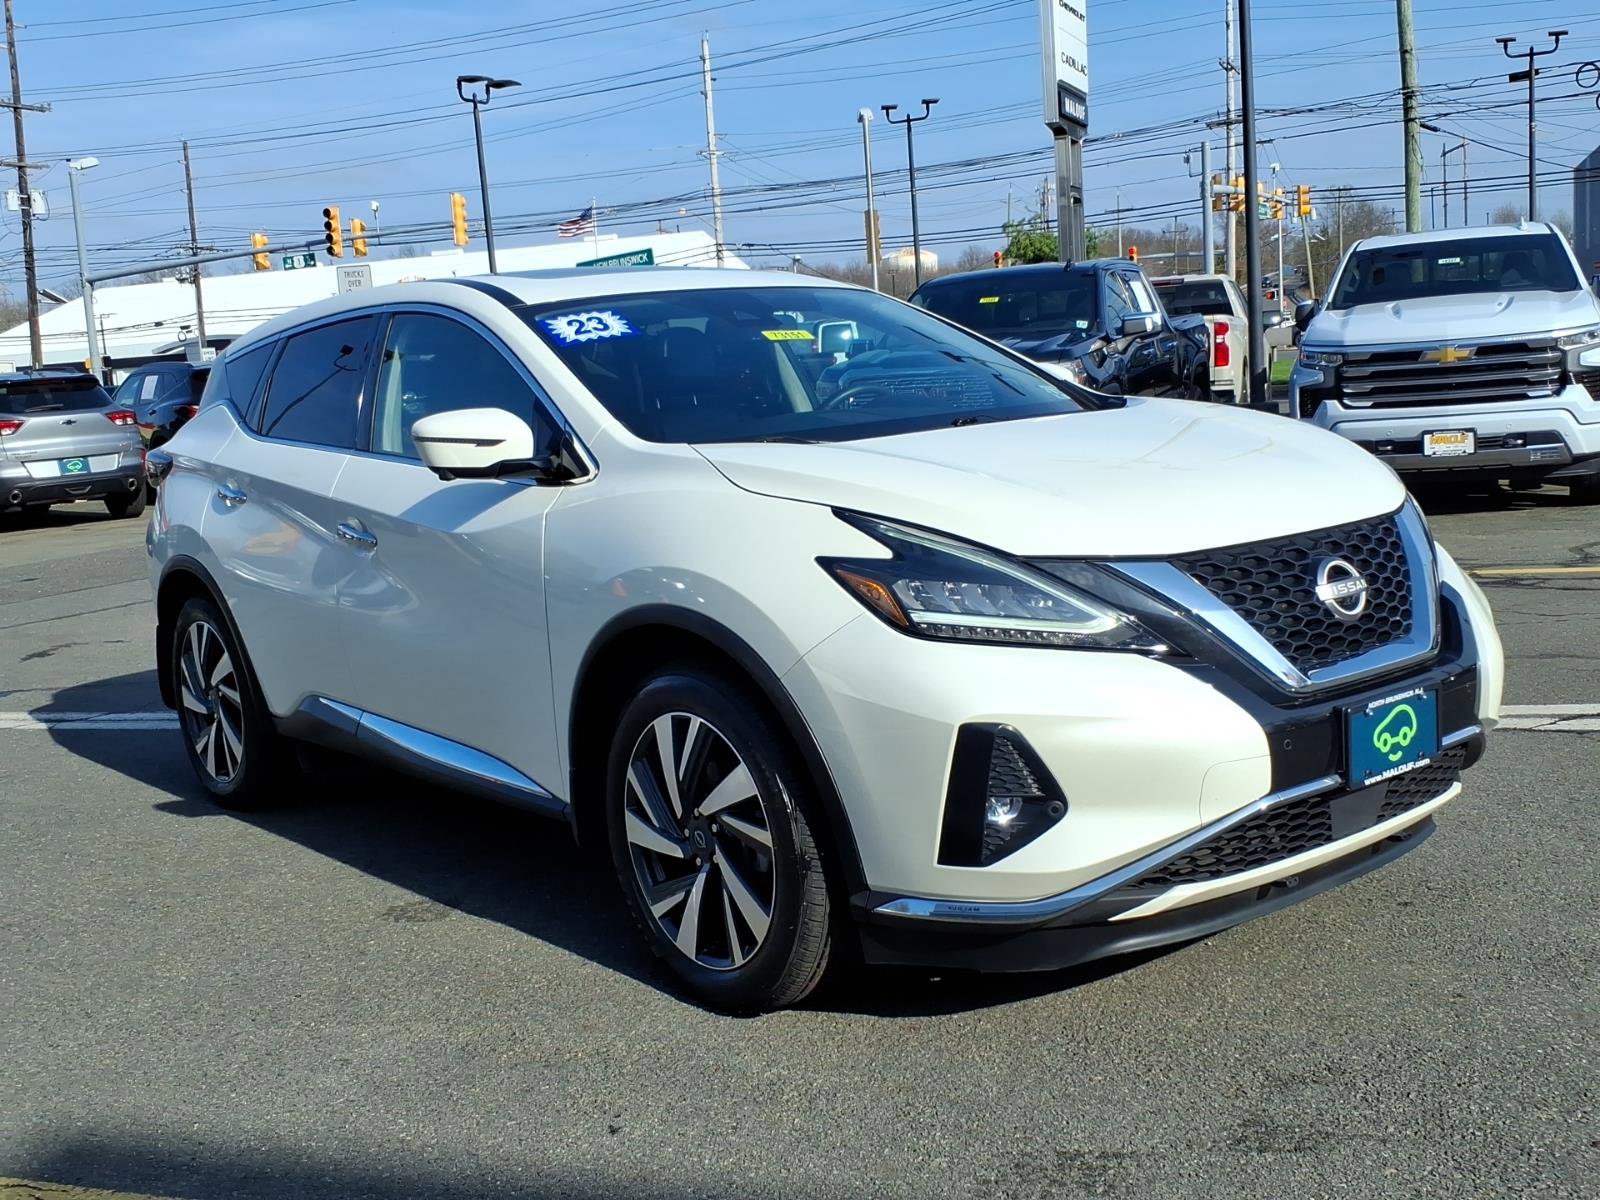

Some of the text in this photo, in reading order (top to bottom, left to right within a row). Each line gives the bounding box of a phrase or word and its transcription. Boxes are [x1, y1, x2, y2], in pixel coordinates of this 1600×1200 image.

[1061, 52, 1087, 76] CADILLAC
[1064, 97, 1085, 120] MALOUF
[344, 271, 364, 279] TRUCKS
[347, 280, 362, 288] OVER
[566, 316, 610, 335] 23
[1322, 579, 1367, 597] ISSAN
[1363, 758, 1431, 786] www.MALOUF.com
